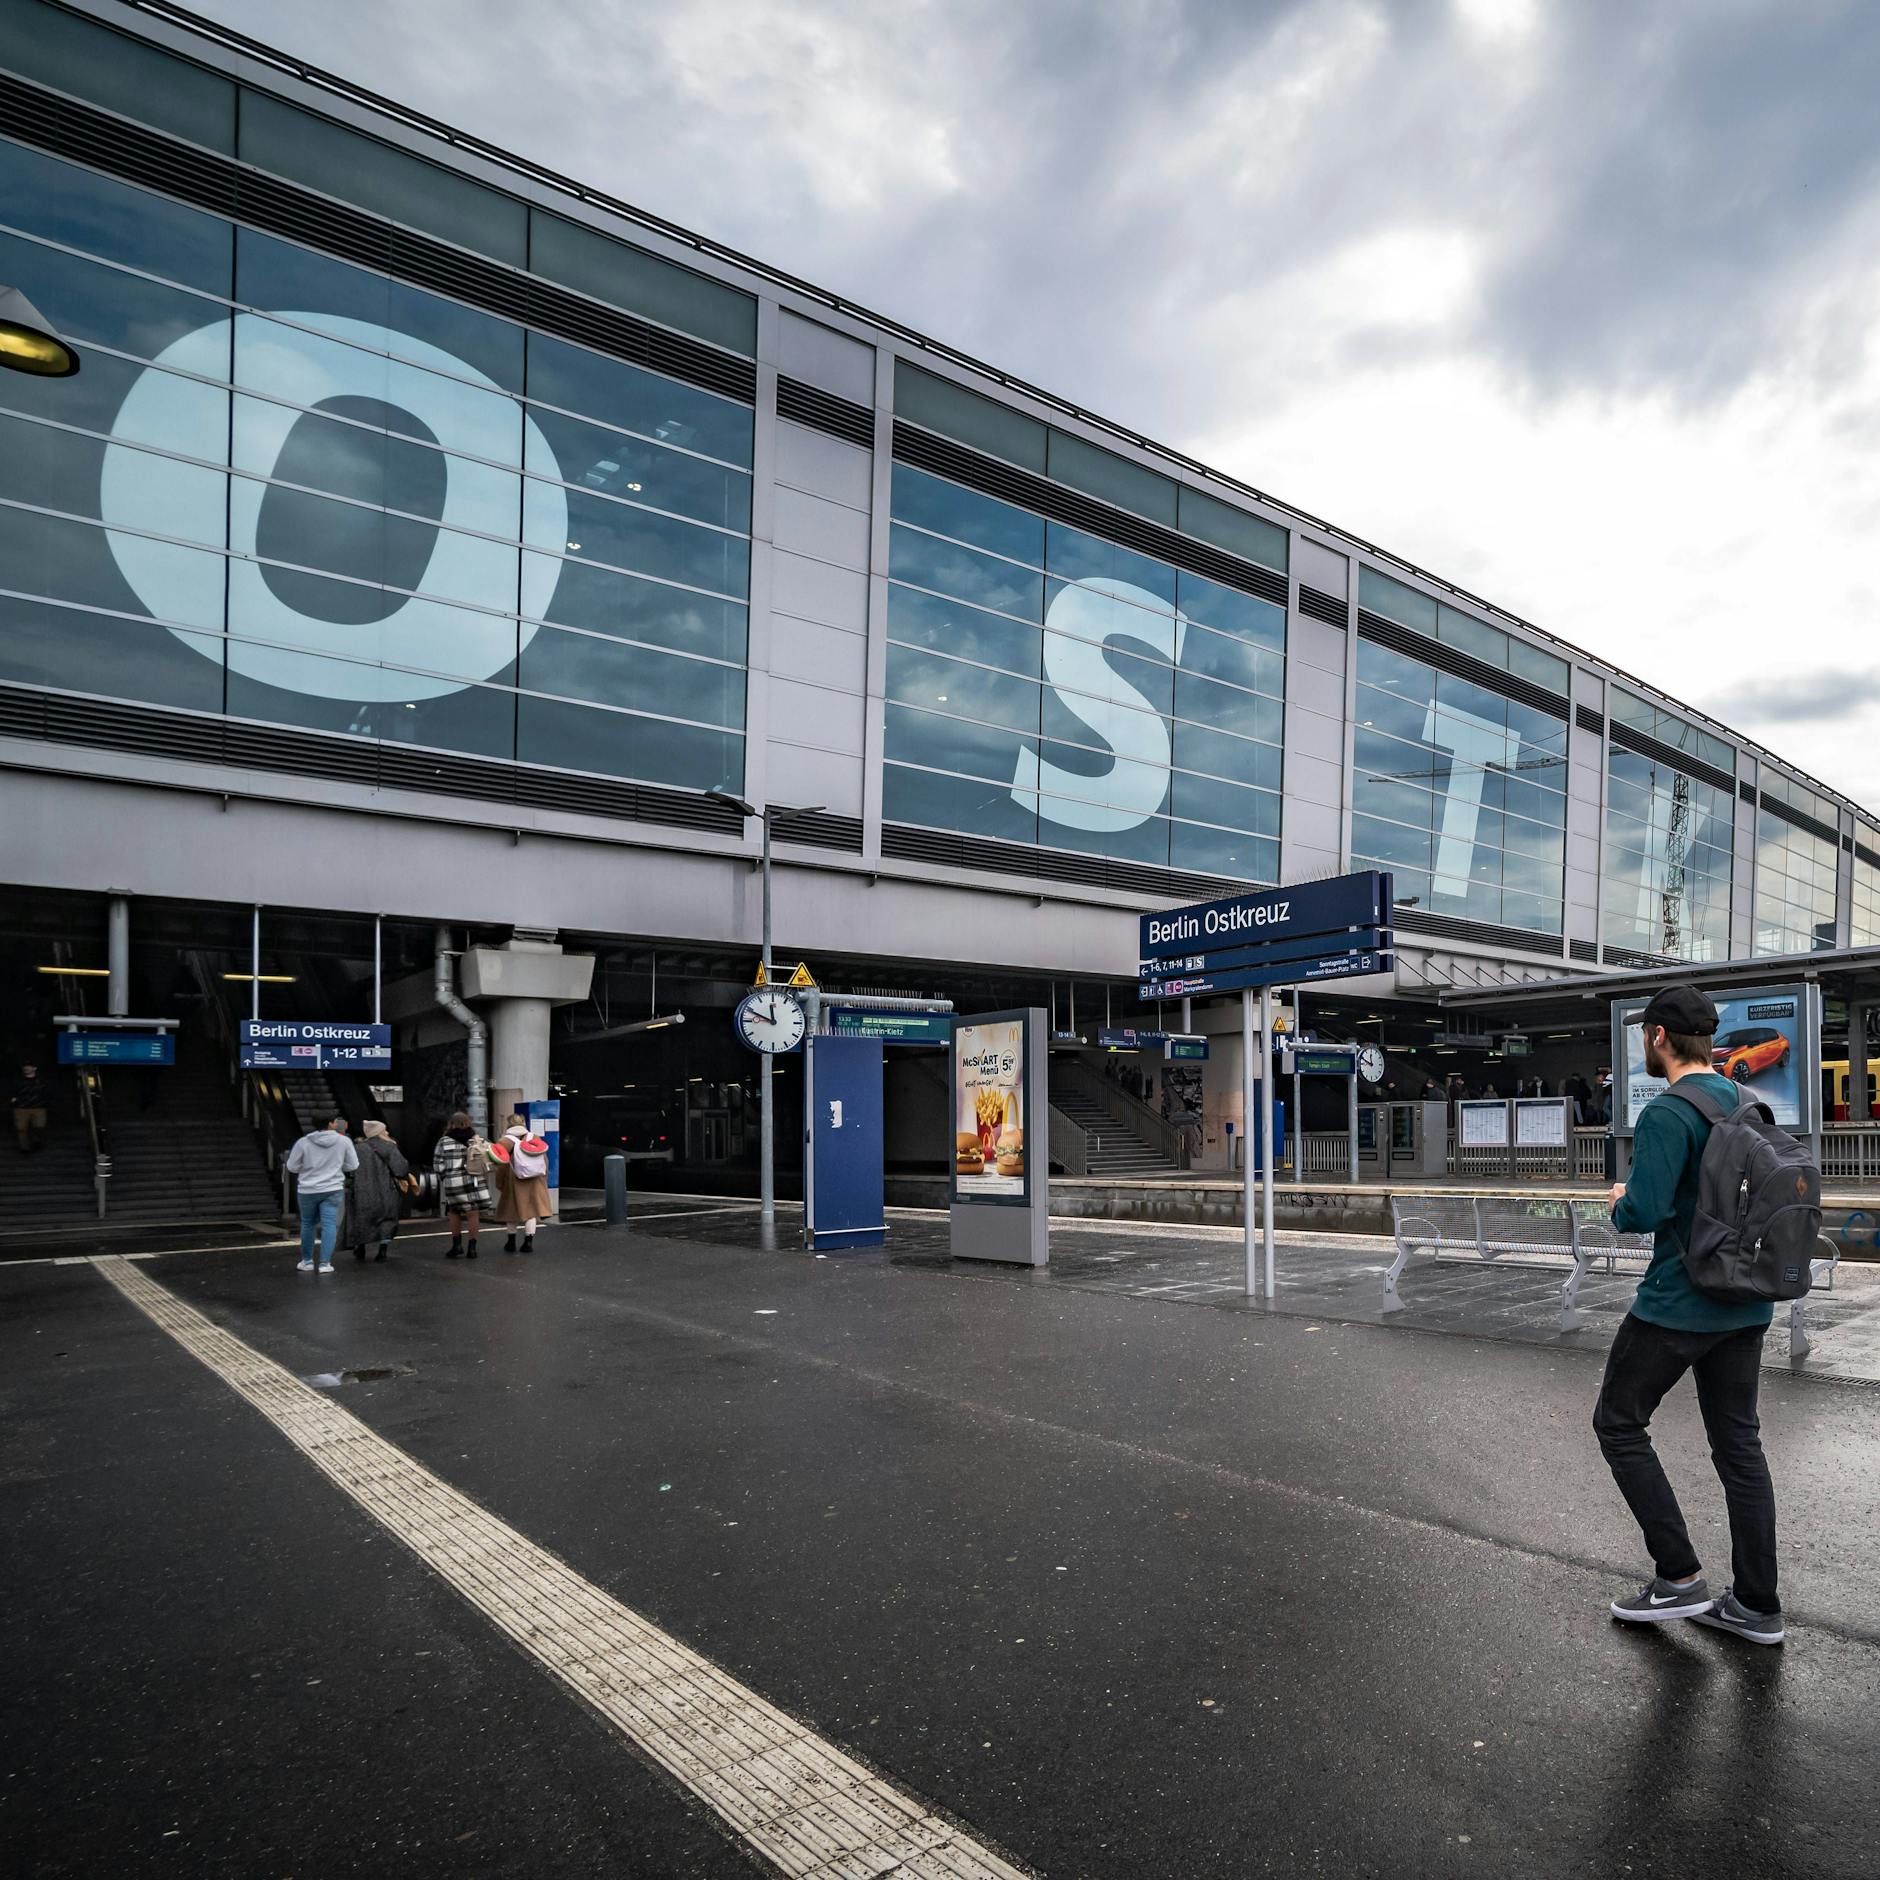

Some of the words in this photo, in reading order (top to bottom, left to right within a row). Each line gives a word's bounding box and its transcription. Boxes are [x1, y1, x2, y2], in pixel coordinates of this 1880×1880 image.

[1149, 915, 1199, 944] Berlin
[1204, 901, 1291, 935] Ostkreuz
[1150, 962, 1161, 973] 1-6,
[1168, 958, 1183, 970] 11-14
[1749, 1003, 1793, 1013] KURZFRISTIG
[249, 1024, 297, 1037] Berlin
[302, 1025, 371, 1040] Ostkreuz
[332, 1048, 357, 1059] 1-12
